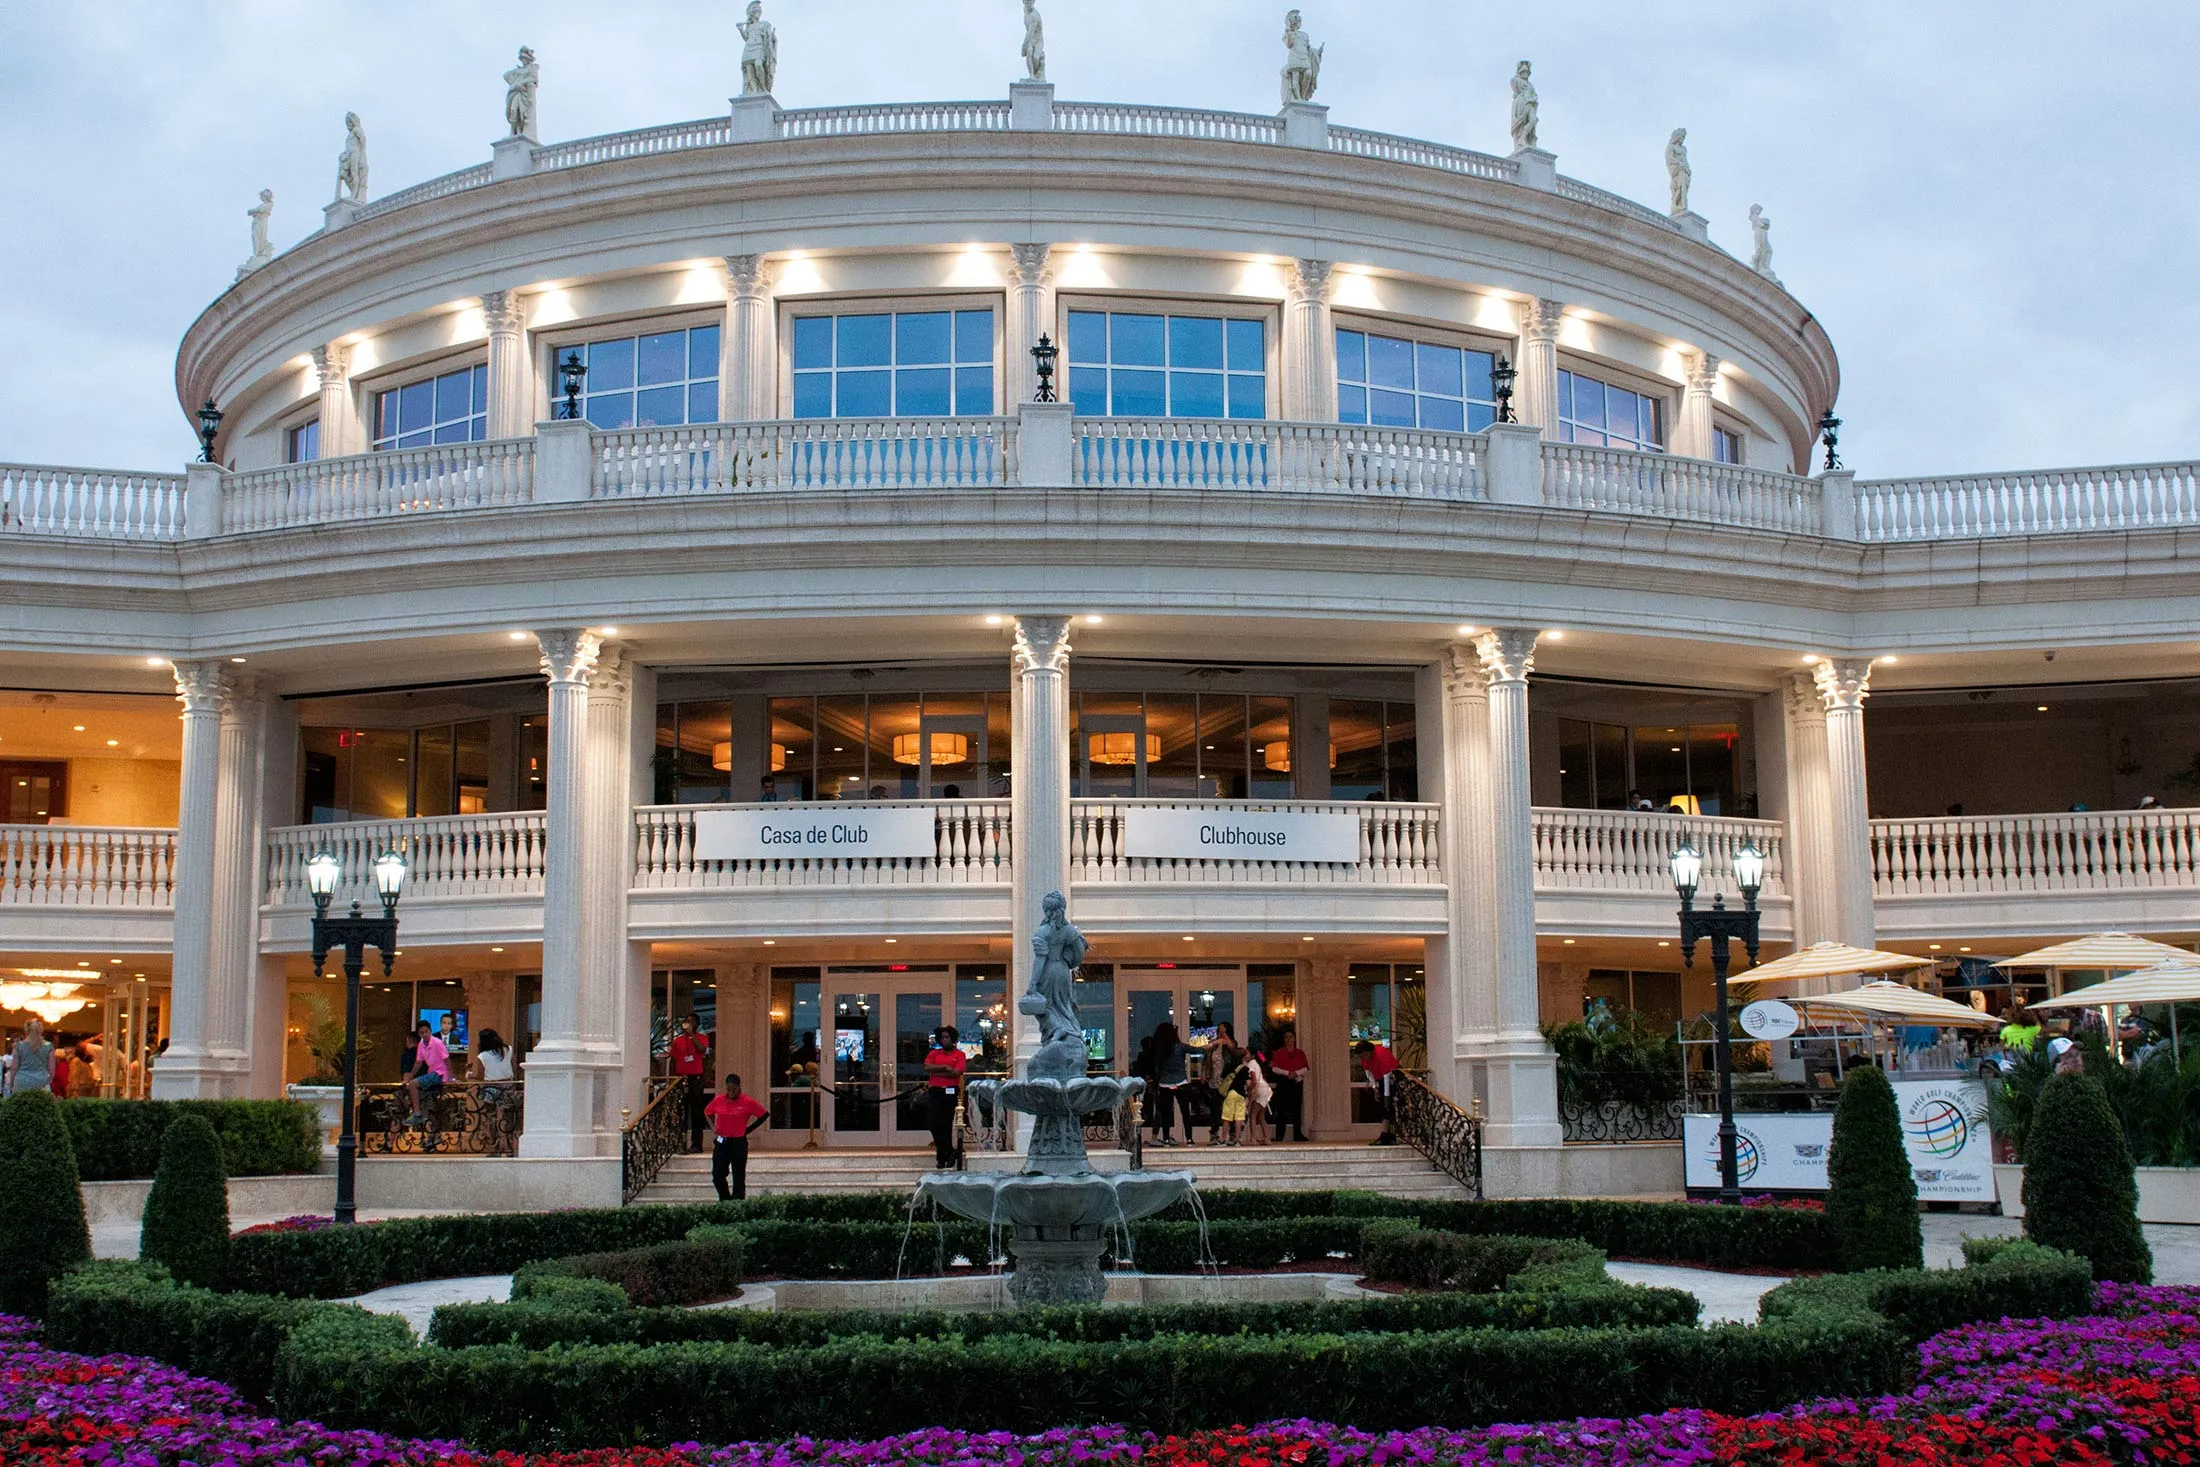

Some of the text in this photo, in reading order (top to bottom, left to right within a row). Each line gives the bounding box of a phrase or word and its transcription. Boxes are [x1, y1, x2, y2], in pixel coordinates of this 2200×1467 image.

[761, 824, 868, 844] Casa de Club
[1200, 825, 1286, 845] Clubhouse
[1909, 1095, 1926, 1116] WORLD
[1926, 1089, 1941, 1098] GOLF
[1920, 1185, 1983, 1194] HAMPIONSHIP
